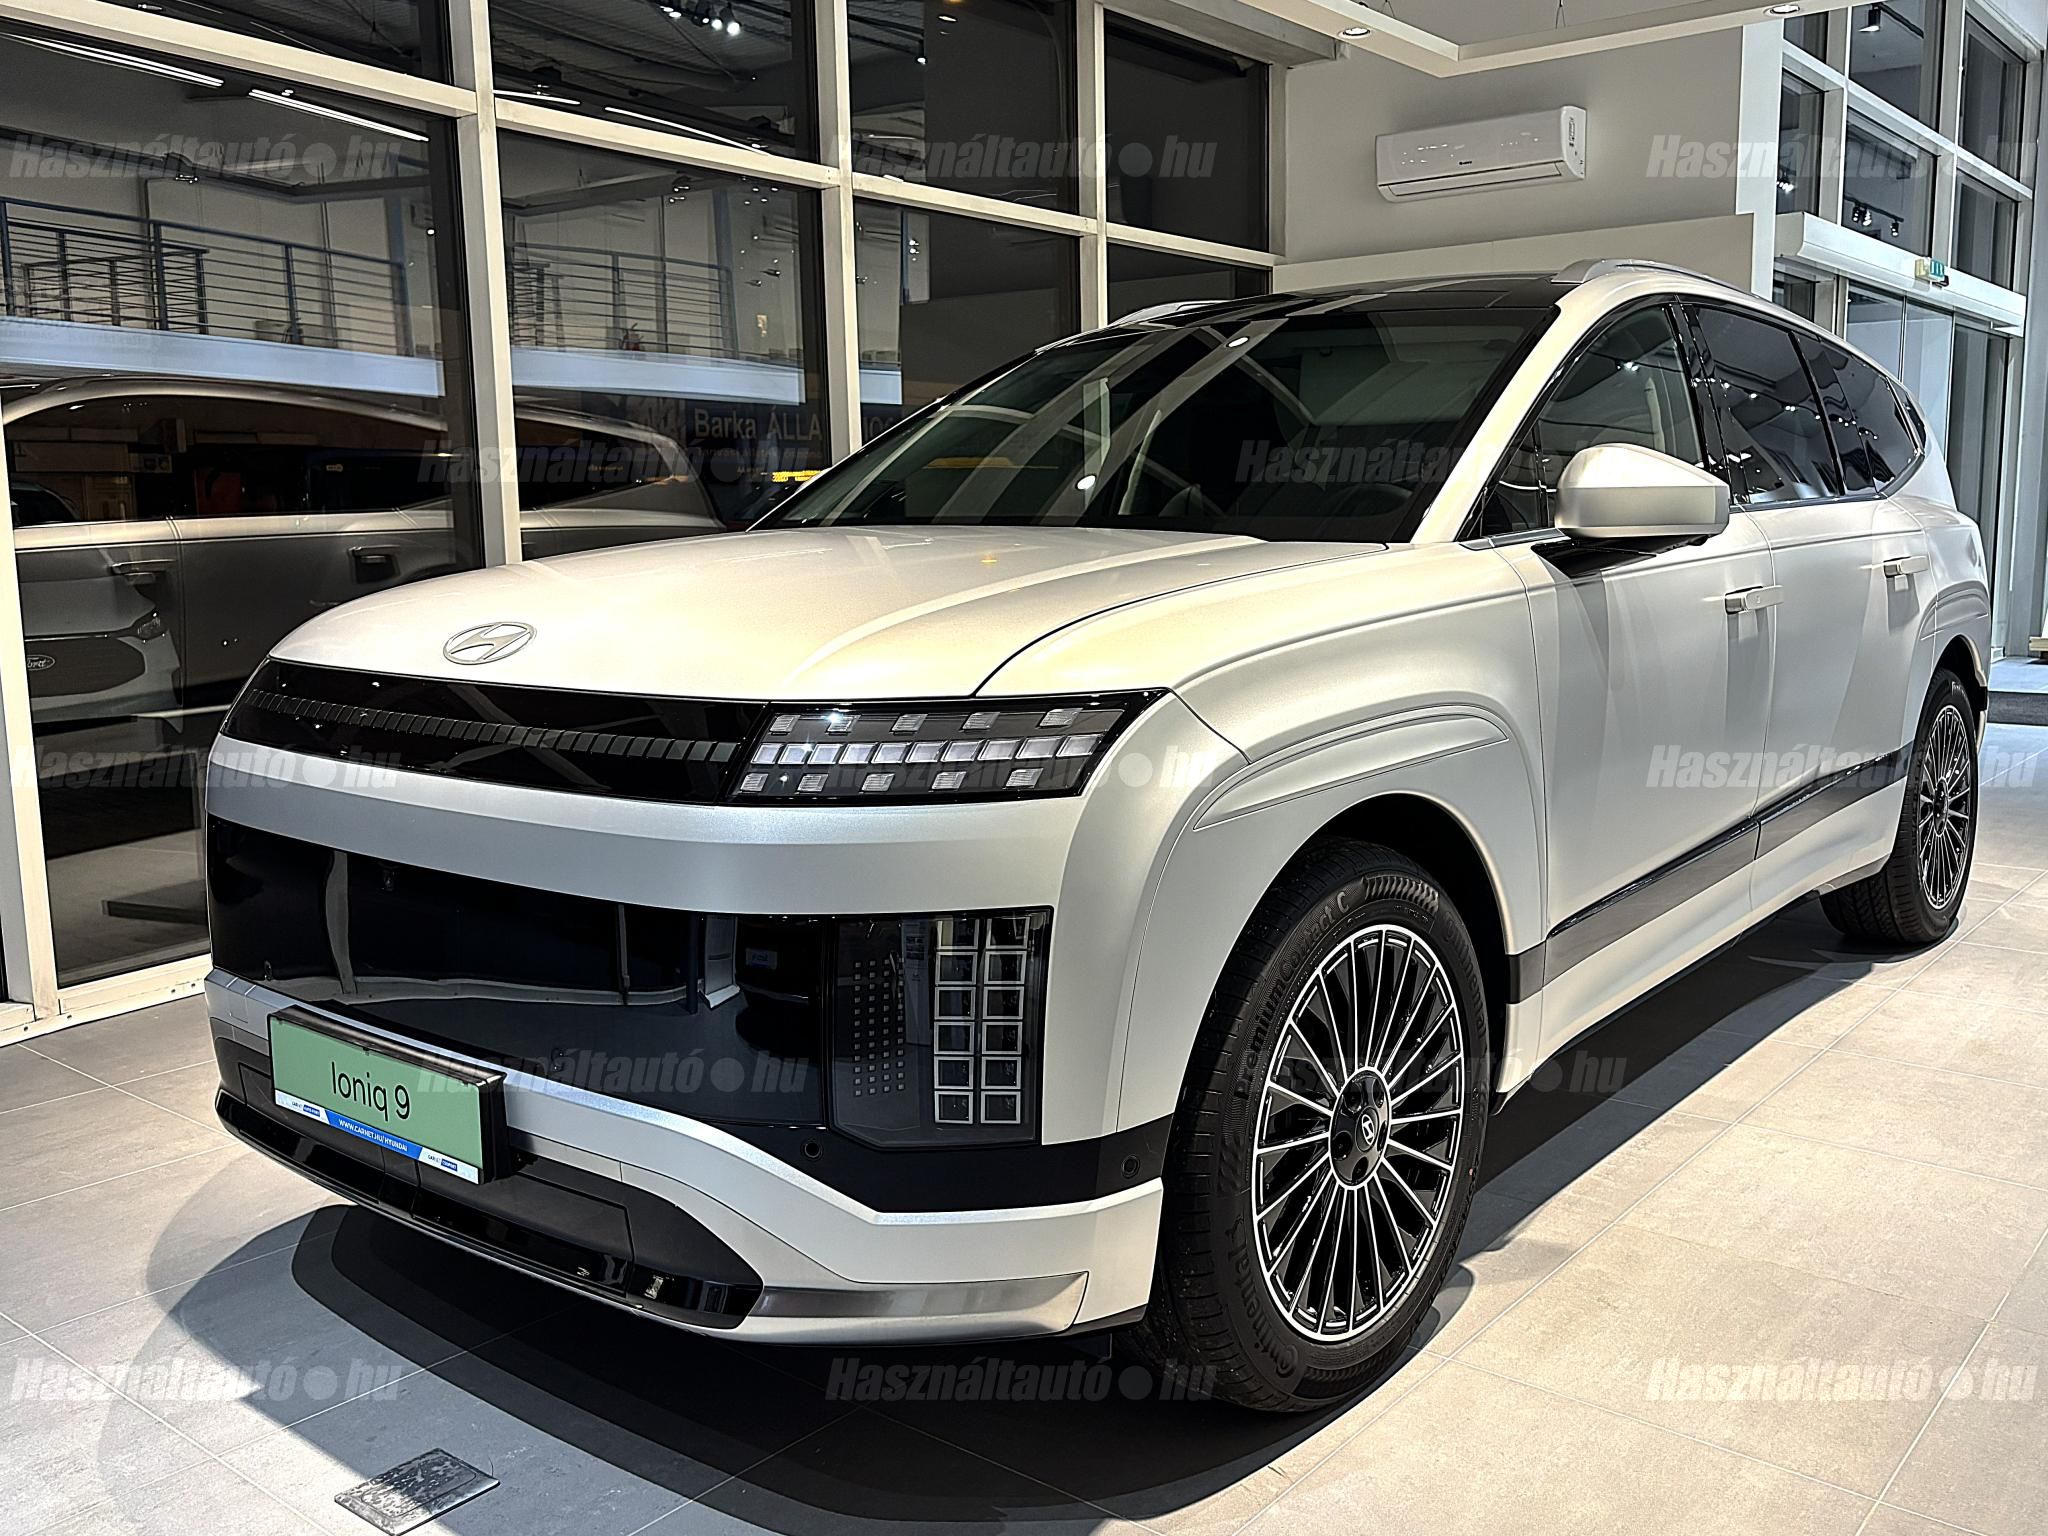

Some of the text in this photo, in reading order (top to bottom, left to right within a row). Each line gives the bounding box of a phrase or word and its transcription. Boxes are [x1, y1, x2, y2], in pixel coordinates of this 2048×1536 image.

[694, 408, 757, 440] Barka
[331, 1061, 411, 1122] Ioniq 9
